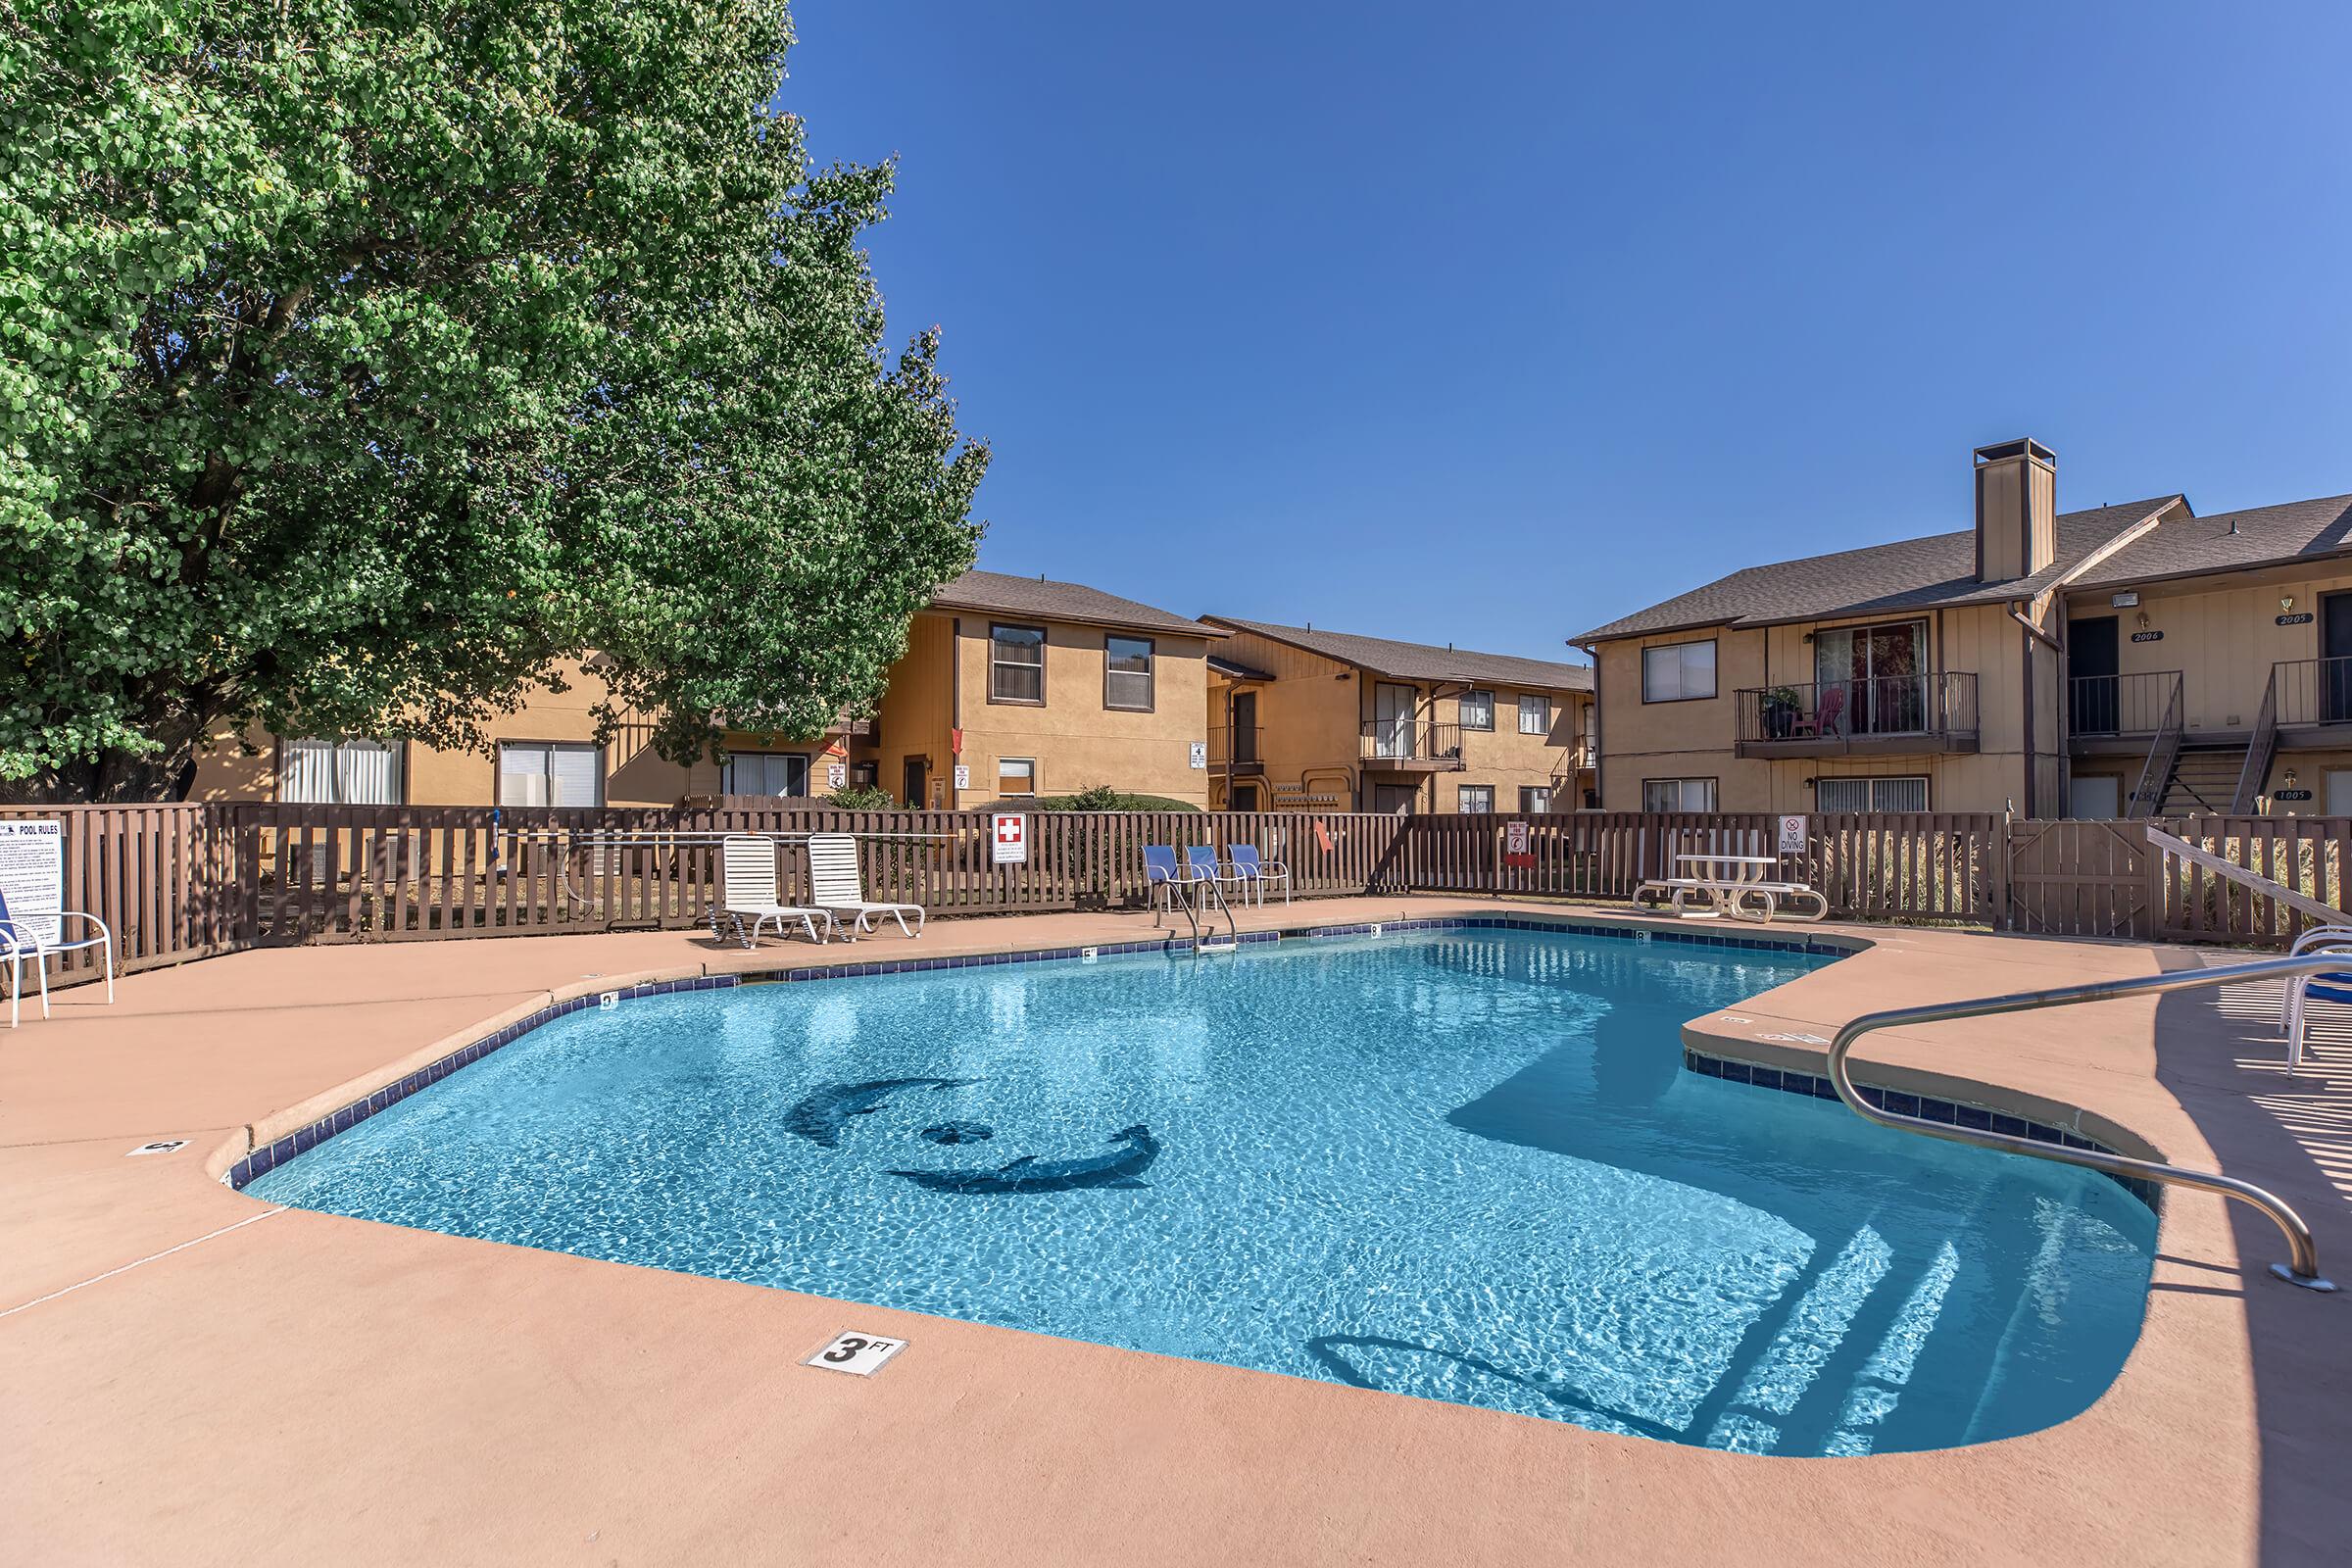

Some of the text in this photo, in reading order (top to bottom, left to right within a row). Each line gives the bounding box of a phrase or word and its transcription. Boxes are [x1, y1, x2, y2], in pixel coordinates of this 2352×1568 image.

[2280, 614, 2306, 624] 2005
[2134, 632, 2158, 642] 2006
[2280, 791, 2305, 800] 1005
[20, 824, 58, 835] POOL RULES
[1787, 831, 1798, 841] NO
[1781, 840, 1804, 850] DIVING
[1084, 950, 1091, 960] 5
[823, 1338, 894, 1363] 3 FT
